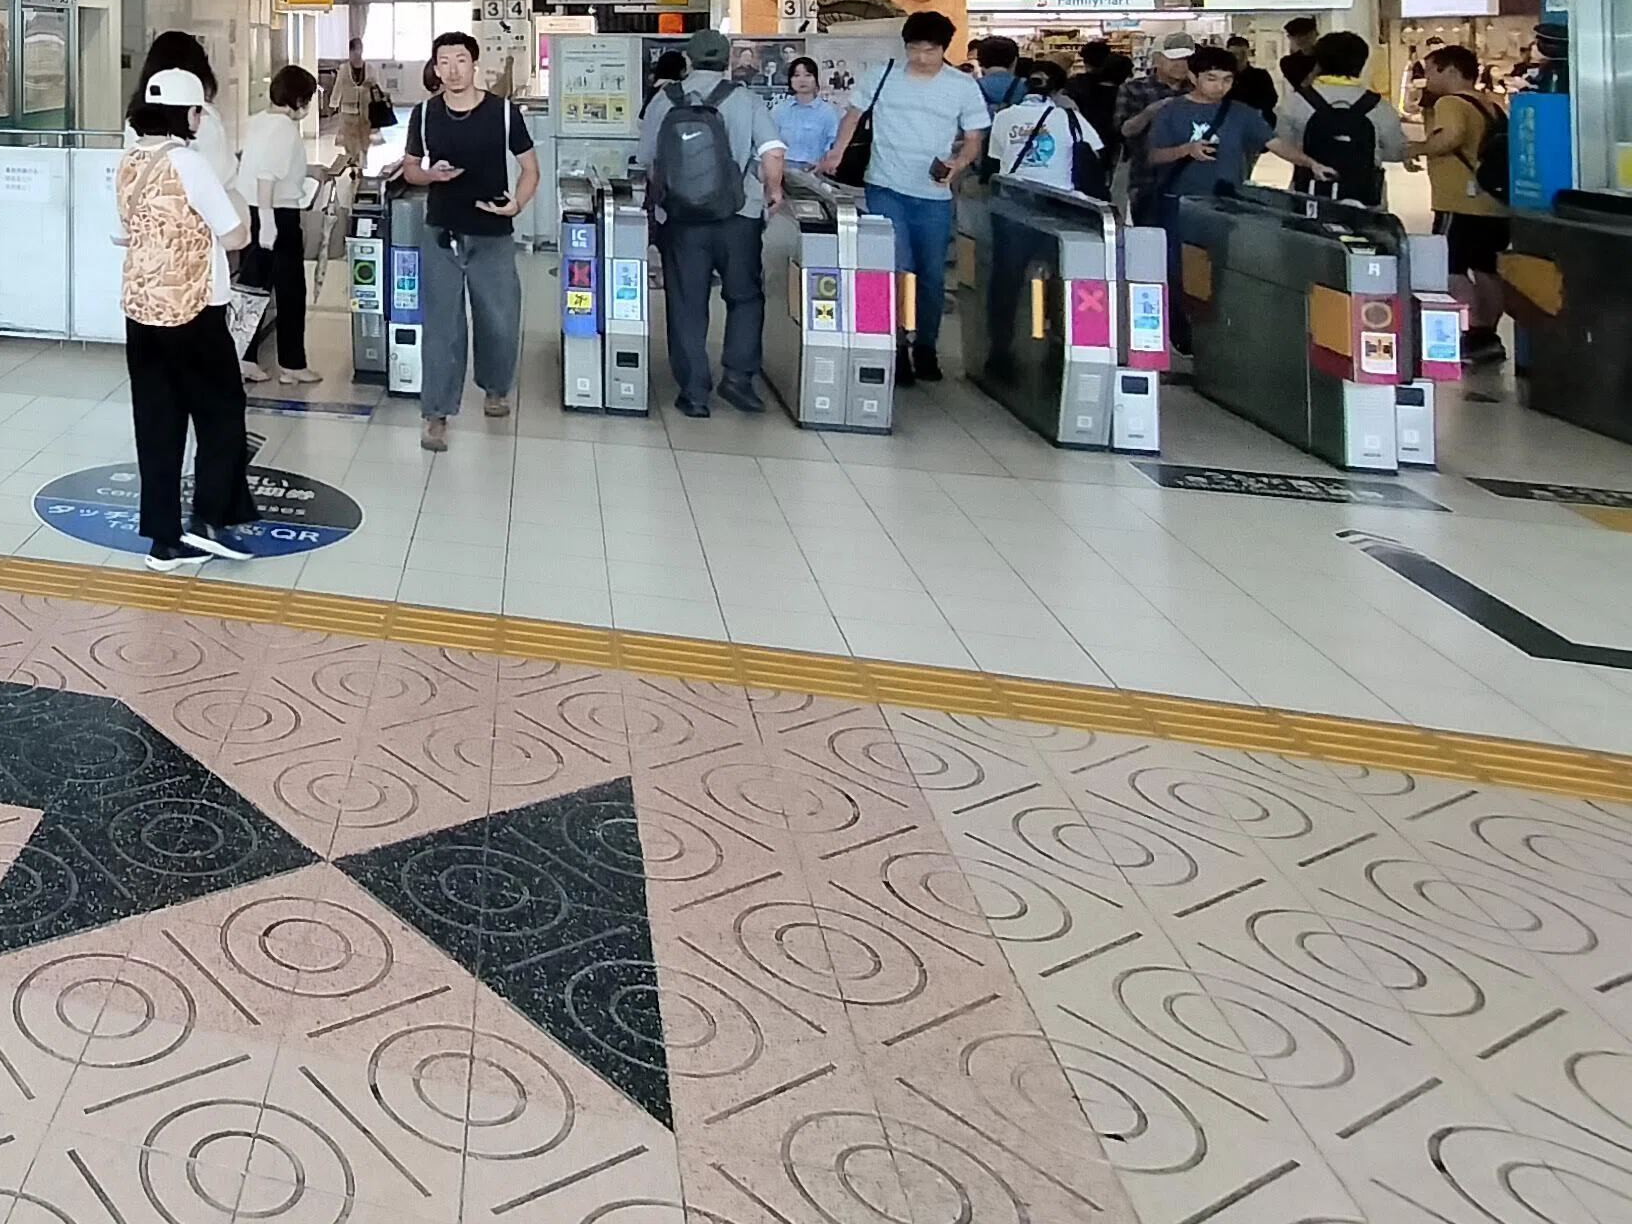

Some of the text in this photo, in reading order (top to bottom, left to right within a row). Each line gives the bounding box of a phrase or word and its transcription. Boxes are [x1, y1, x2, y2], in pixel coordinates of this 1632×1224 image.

[487, 1, 500, 16] 3
[511, 1, 523, 16] 4
[784, 1, 796, 16] 3
[571, 229, 588, 241] IC
[271, 528, 320, 543] QR
